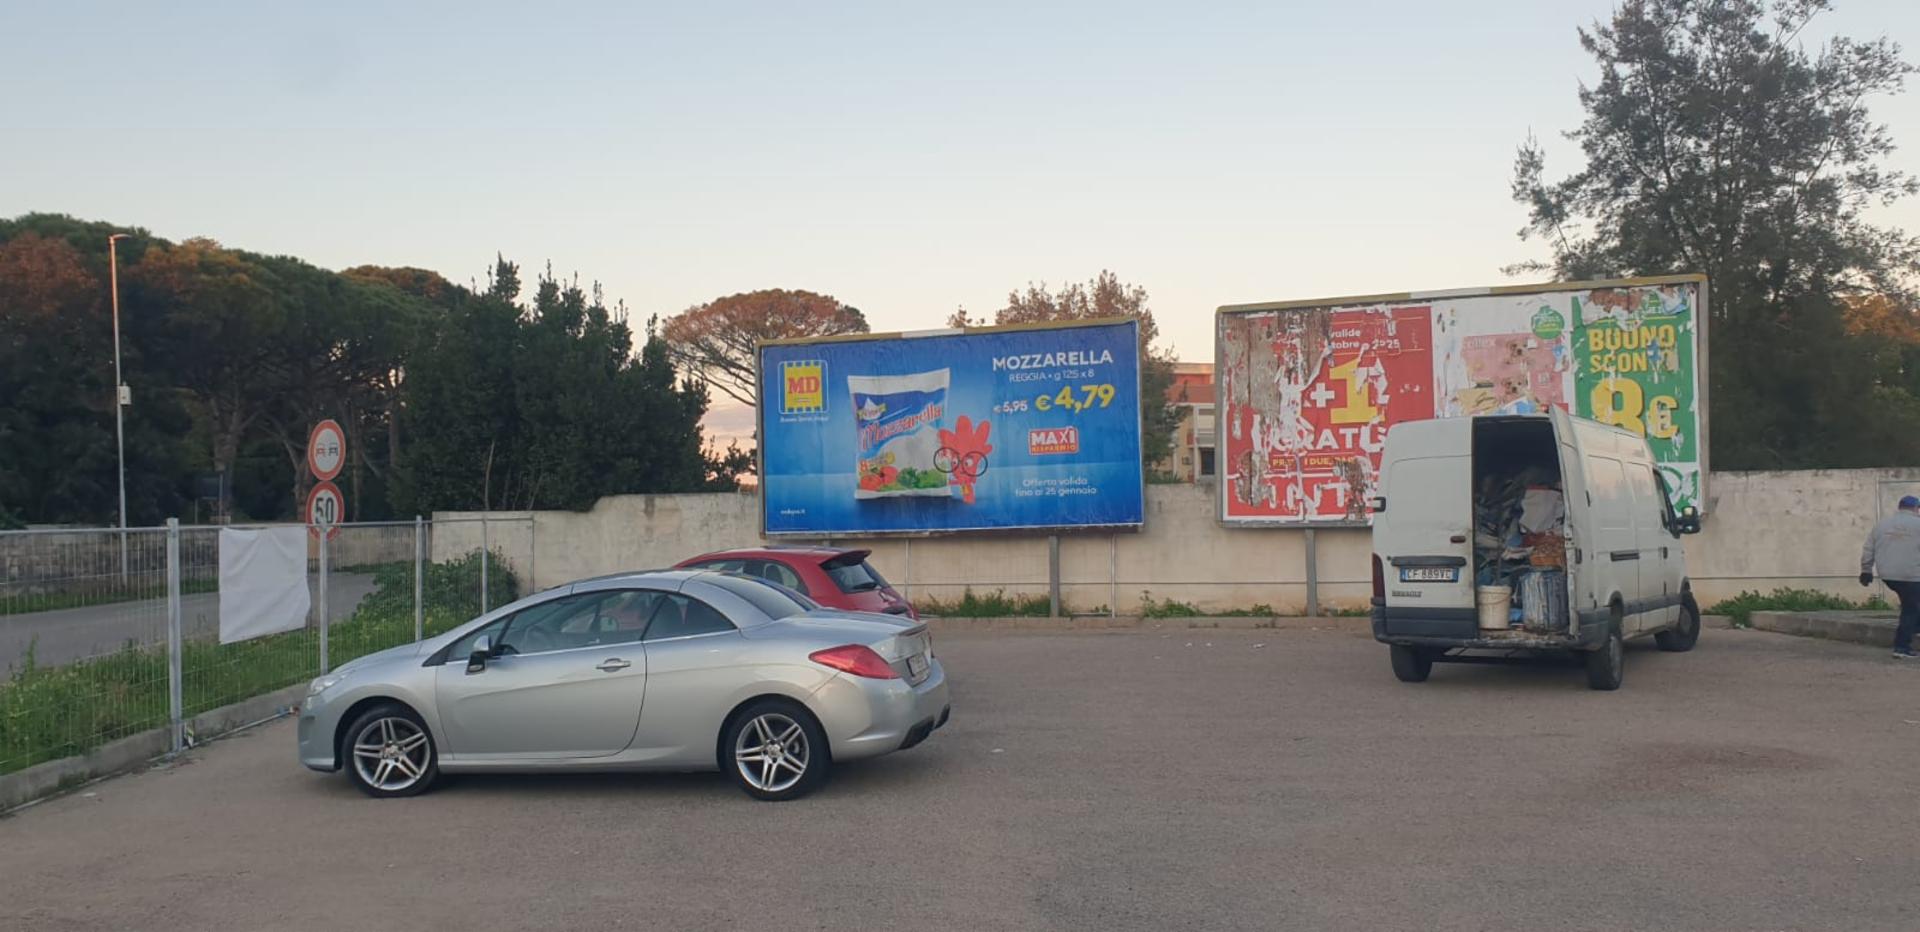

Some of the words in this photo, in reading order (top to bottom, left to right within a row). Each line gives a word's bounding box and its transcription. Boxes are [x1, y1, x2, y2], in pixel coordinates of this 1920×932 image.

[1588, 324, 1675, 352] BUONO
[993, 350, 1113, 371] MOZZARELLA
[1590, 351, 1679, 373] SCONO
[788, 376, 820, 394] MD
[1009, 372, 1047, 383] REGGIA
[1063, 369, 1079, 379] 125
[1081, 371, 1087, 379] x
[1088, 368, 1095, 378] 8
[1003, 400, 1029, 415] 5,95
[1035, 394, 1052, 411] €
[1055, 384, 1115, 415] 4,79
[862, 402, 944, 451] Mozzarella
[1032, 445, 1077, 453] RISPARMIO
[1023, 478, 1056, 487] Offerta
[1059, 475, 1088, 485] valida
[1016, 488, 1033, 496] fino
[1045, 487, 1057, 495] 25
[1058, 486, 1097, 497] gennaio
[315, 497, 334, 524] 50
